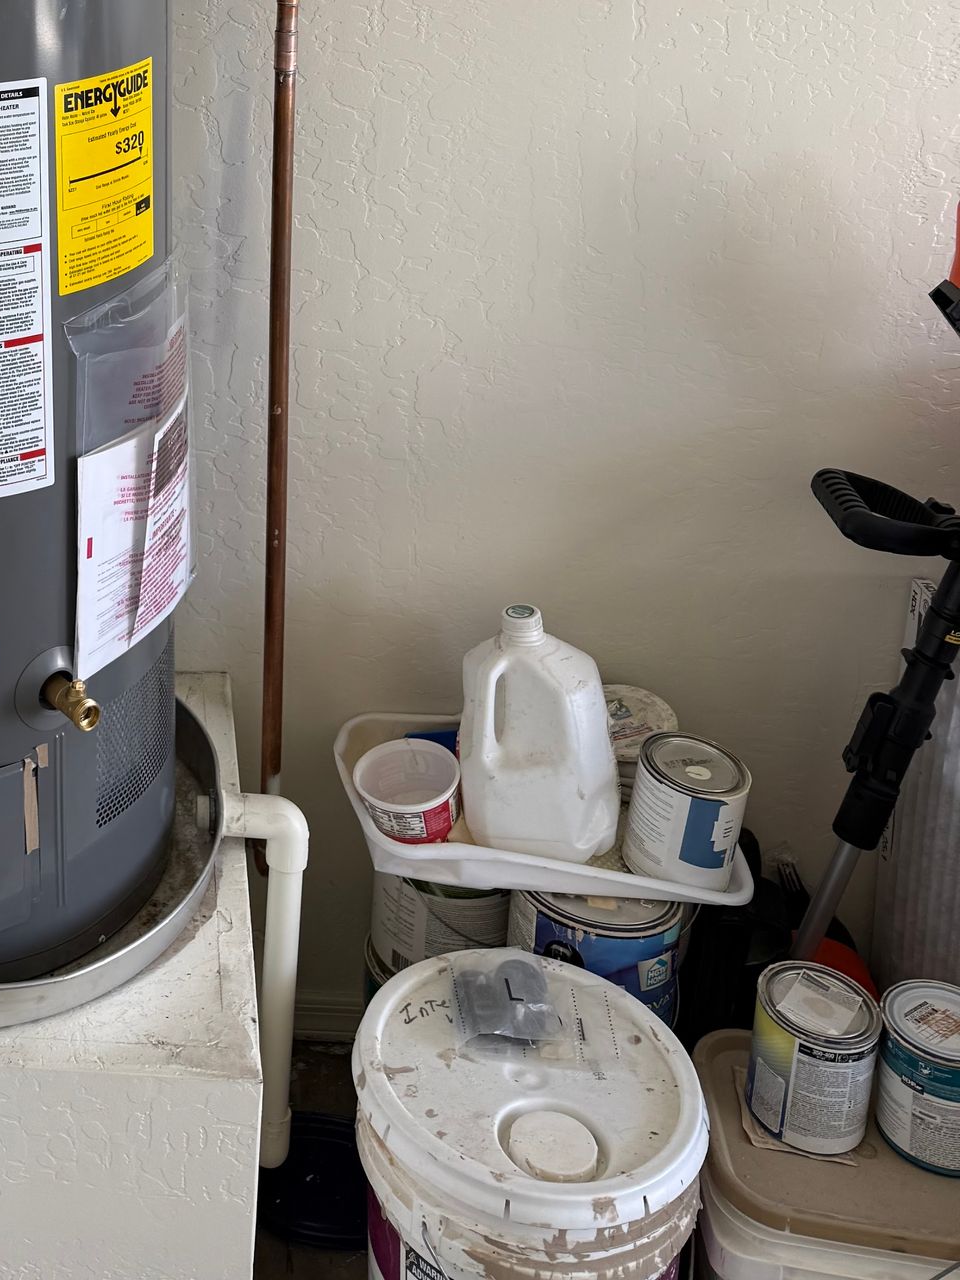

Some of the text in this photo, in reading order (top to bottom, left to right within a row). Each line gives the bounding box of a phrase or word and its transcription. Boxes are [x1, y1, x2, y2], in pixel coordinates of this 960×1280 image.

[1, 91, 23, 99] DETAILS
[63, 69, 148, 114] ENERGYGUIDE
[115, 130, 144, 155] $320
[647, 973, 667, 985] HOME
